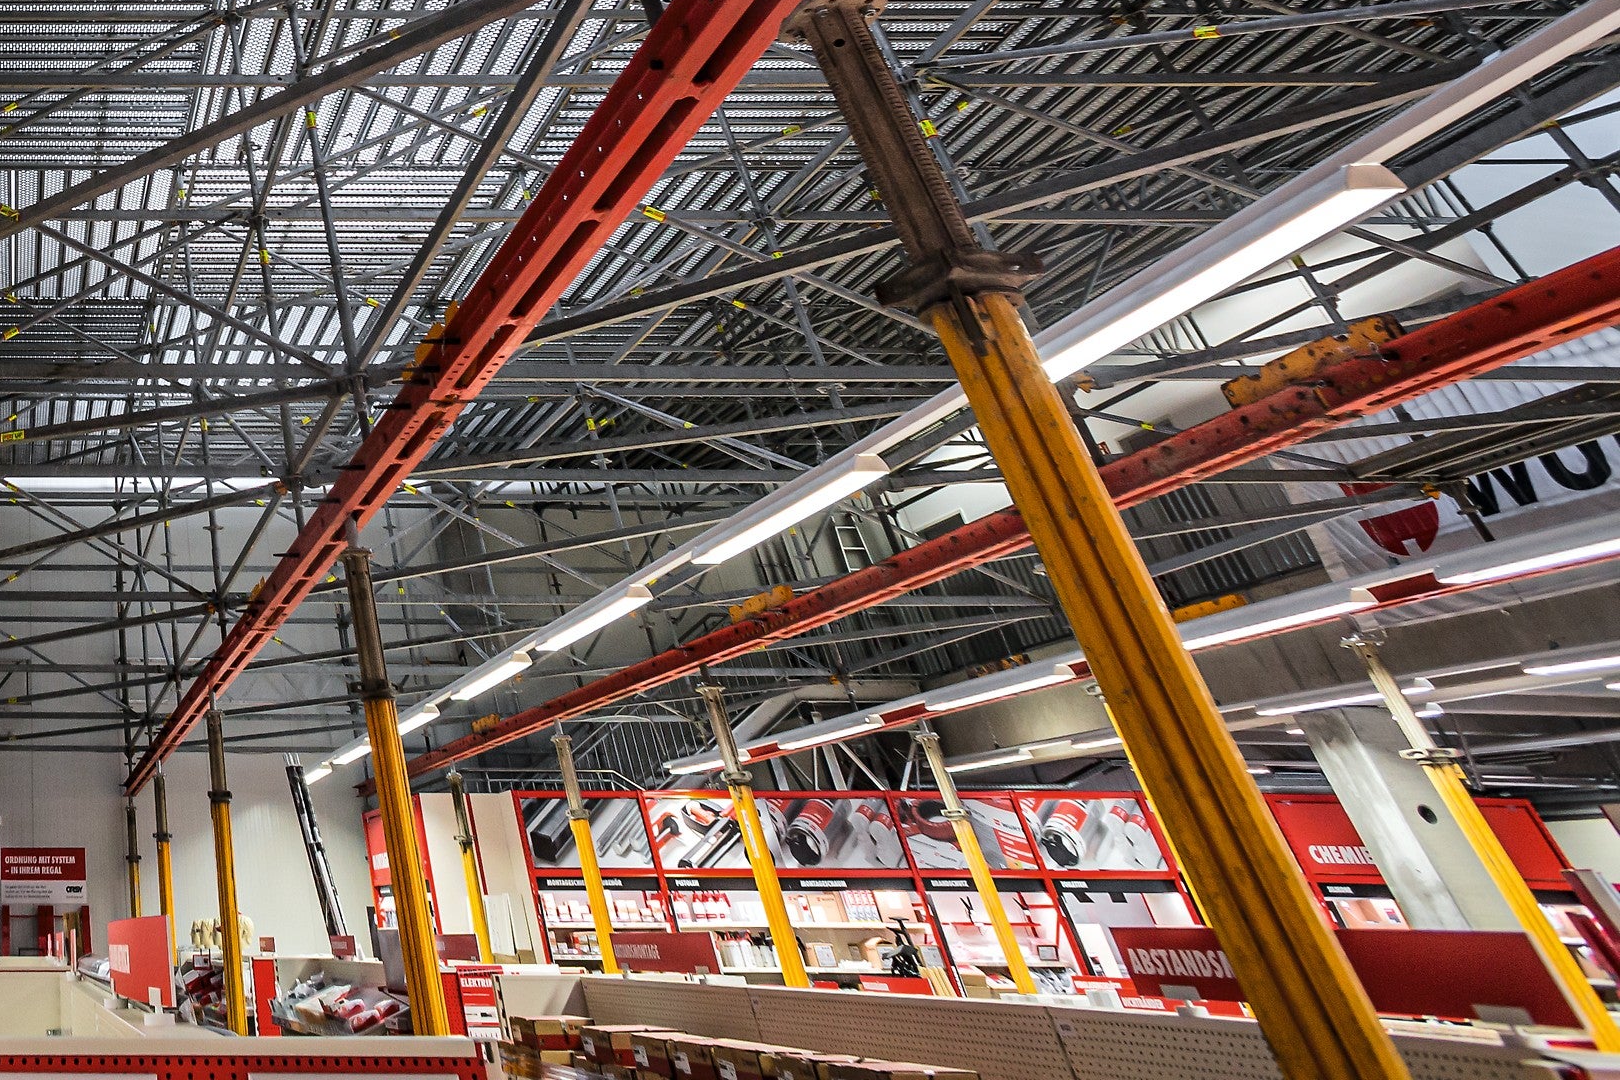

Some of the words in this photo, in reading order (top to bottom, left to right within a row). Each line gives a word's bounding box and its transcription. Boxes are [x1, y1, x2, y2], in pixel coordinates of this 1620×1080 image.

[4, 855, 37, 864] ORDNUNG
[38, 855, 51, 864] MIT
[51, 855, 76, 864] SYSTEM
[19, 866, 41, 875] IHREM
[41, 866, 62, 875] REGAL
